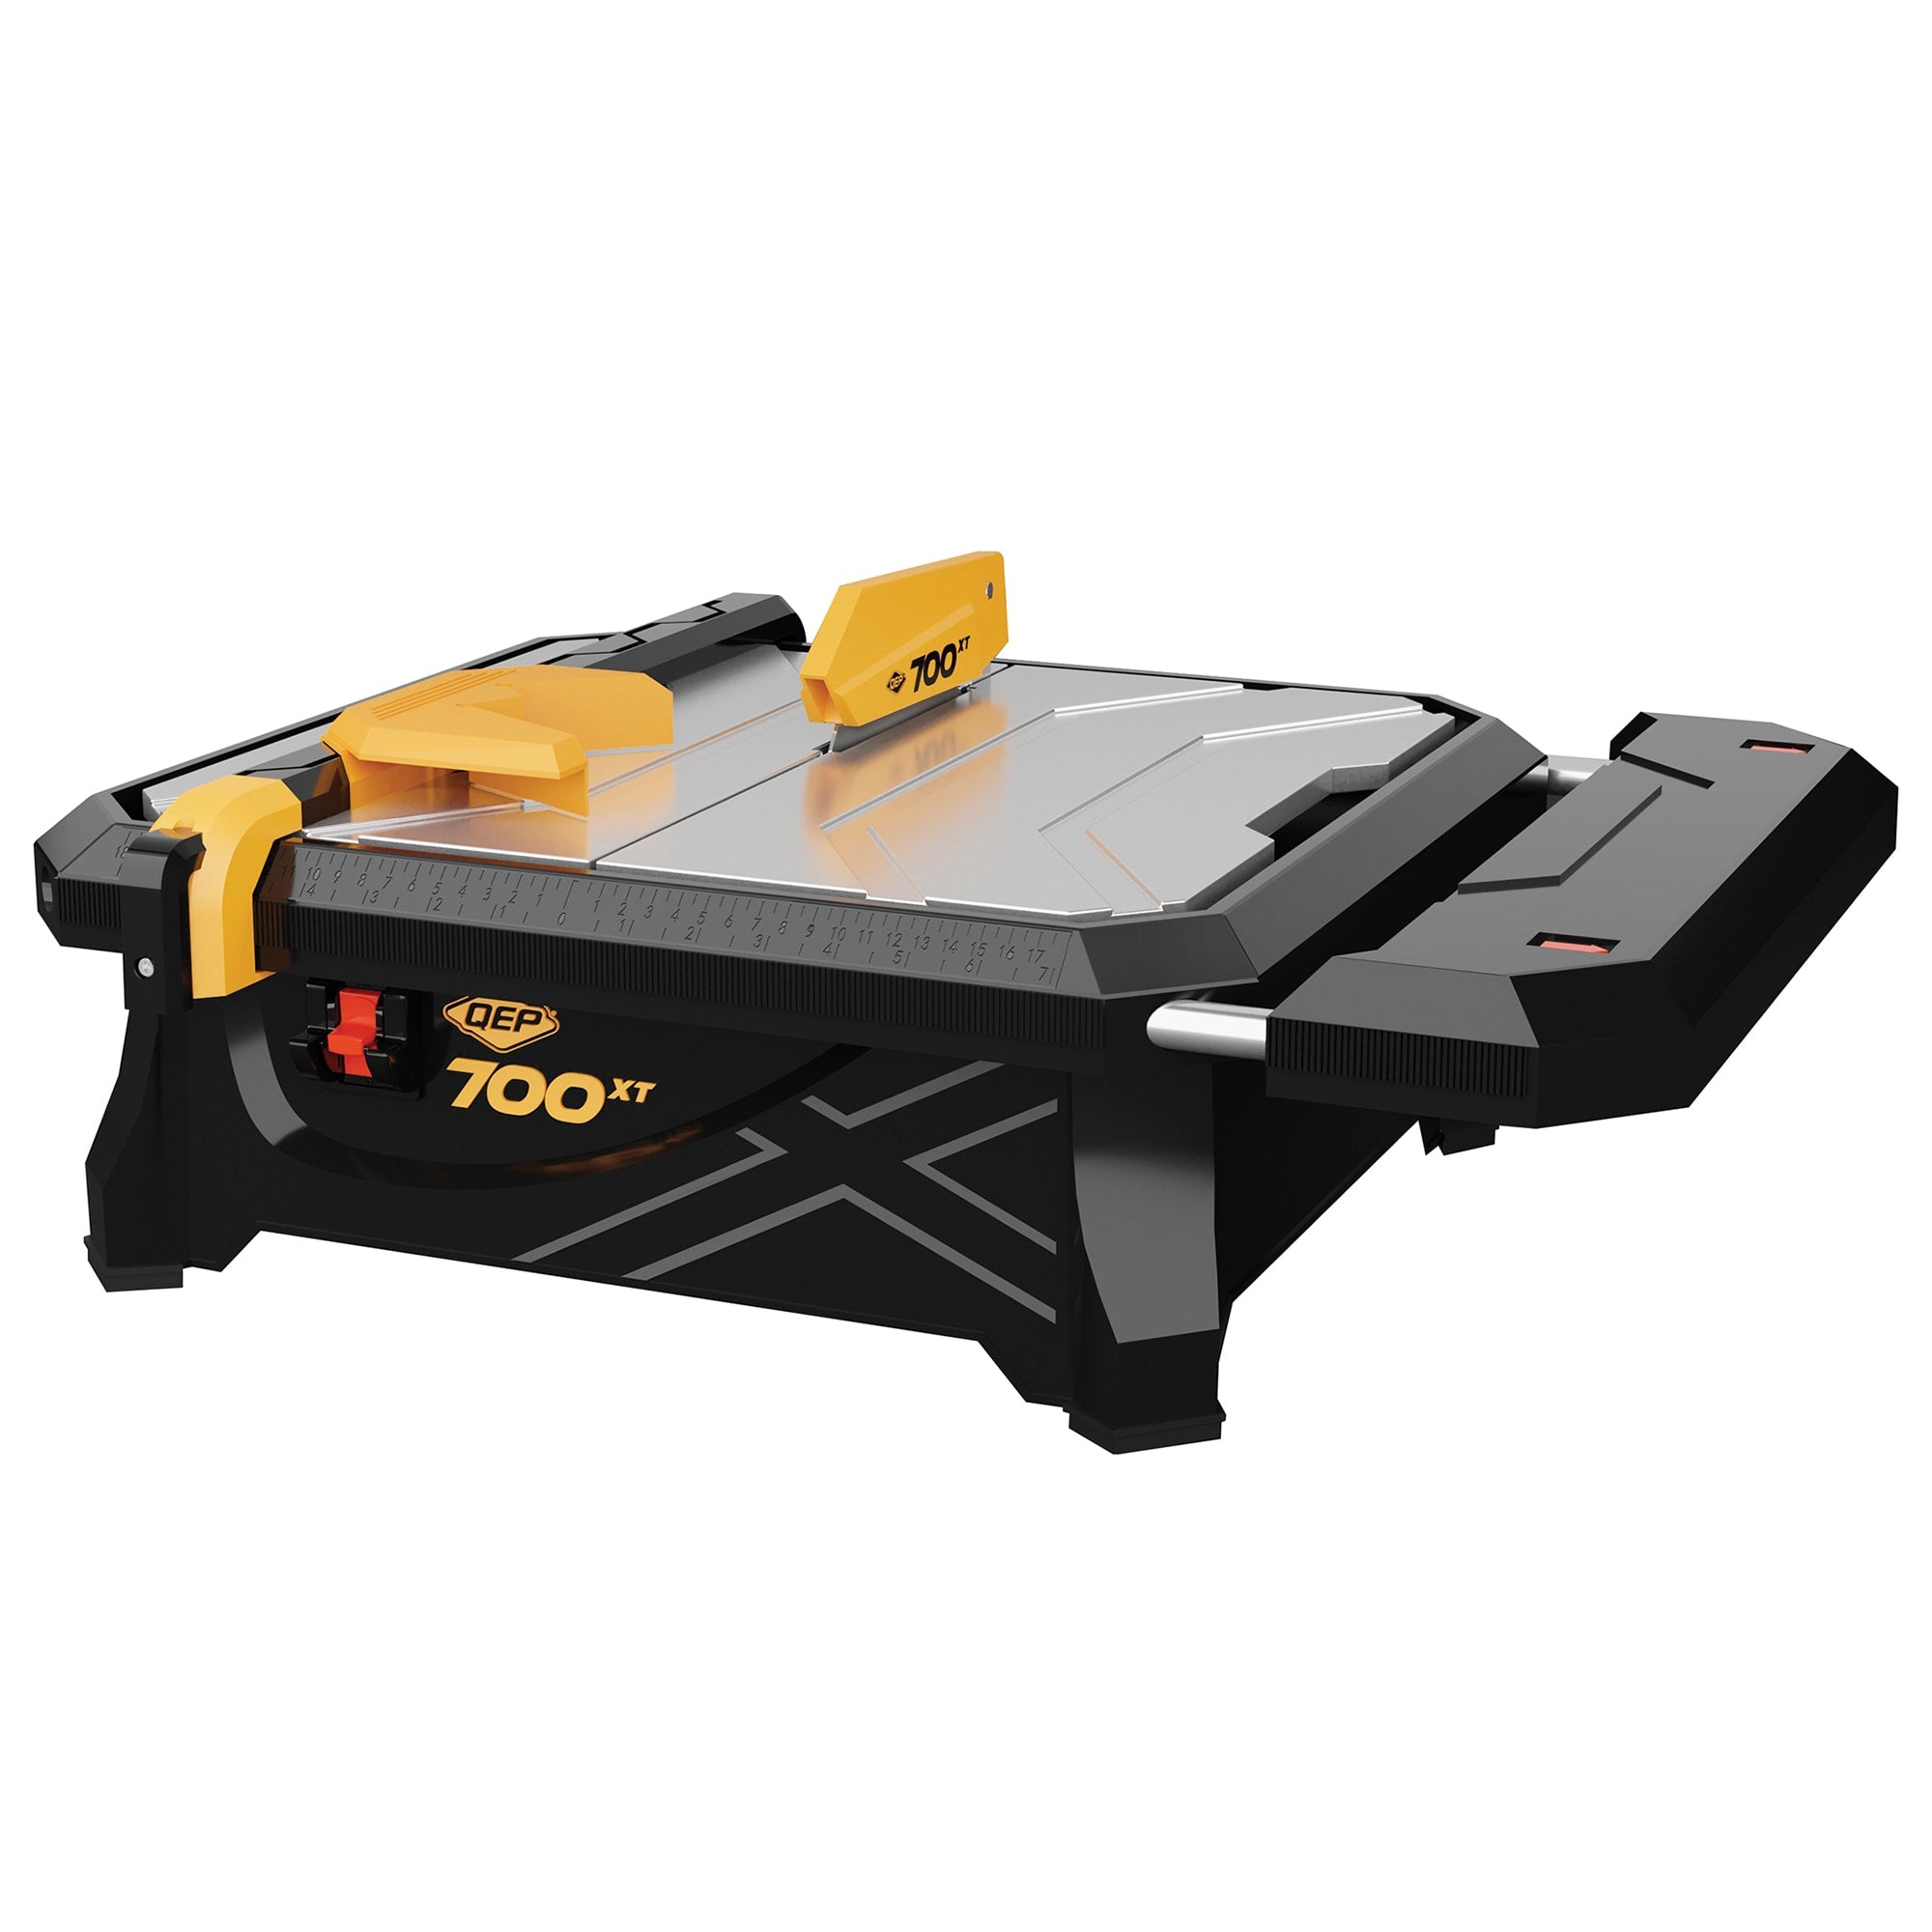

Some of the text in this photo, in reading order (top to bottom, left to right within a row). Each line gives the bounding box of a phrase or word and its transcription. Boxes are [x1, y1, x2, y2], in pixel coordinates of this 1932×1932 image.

[306, 883, 316, 896] 4
[369, 890, 380, 904] 3
[432, 896, 443, 912] 2
[306, 867, 322, 881] 10
[333, 869, 342, 884] 9
[356, 872, 367, 887] 8
[383, 875, 393, 890] 7
[407, 878, 416, 892] 6
[431, 881, 442, 895] 5
[457, 884, 468, 898] 4
[482, 887, 493, 901] 3
[507, 890, 519, 904] 2
[536, 893, 543, 907] 1
[556, 912, 566, 926] 0
[593, 899, 601, 913] 1
[617, 901, 628, 916] 2
[643, 904, 654, 919] 3
[670, 908, 681, 922] 4
[696, 910, 707, 924] 5
[724, 914, 733, 928] 6
[751, 917, 762, 931] 7
[777, 920, 788, 935] 8
[805, 923, 814, 938] 9
[831, 926, 846, 941] 10
[859, 929, 873, 945] 11
[887, 932, 902, 948] 12
[914, 935, 930, 951] 13
[943, 939, 959, 954] 14
[971, 941, 987, 957] 15
[999, 945, 1015, 960] 16
[1028, 949, 1045, 964] 17
[684, 925, 696, 941] 2
[753, 933, 763, 949] 3
[822, 942, 833, 956] 4
[893, 950, 903, 964] 5
[965, 958, 975, 973] 6
[1038, 966, 1049, 981] 7
[465, 1001, 544, 1034] QEP
